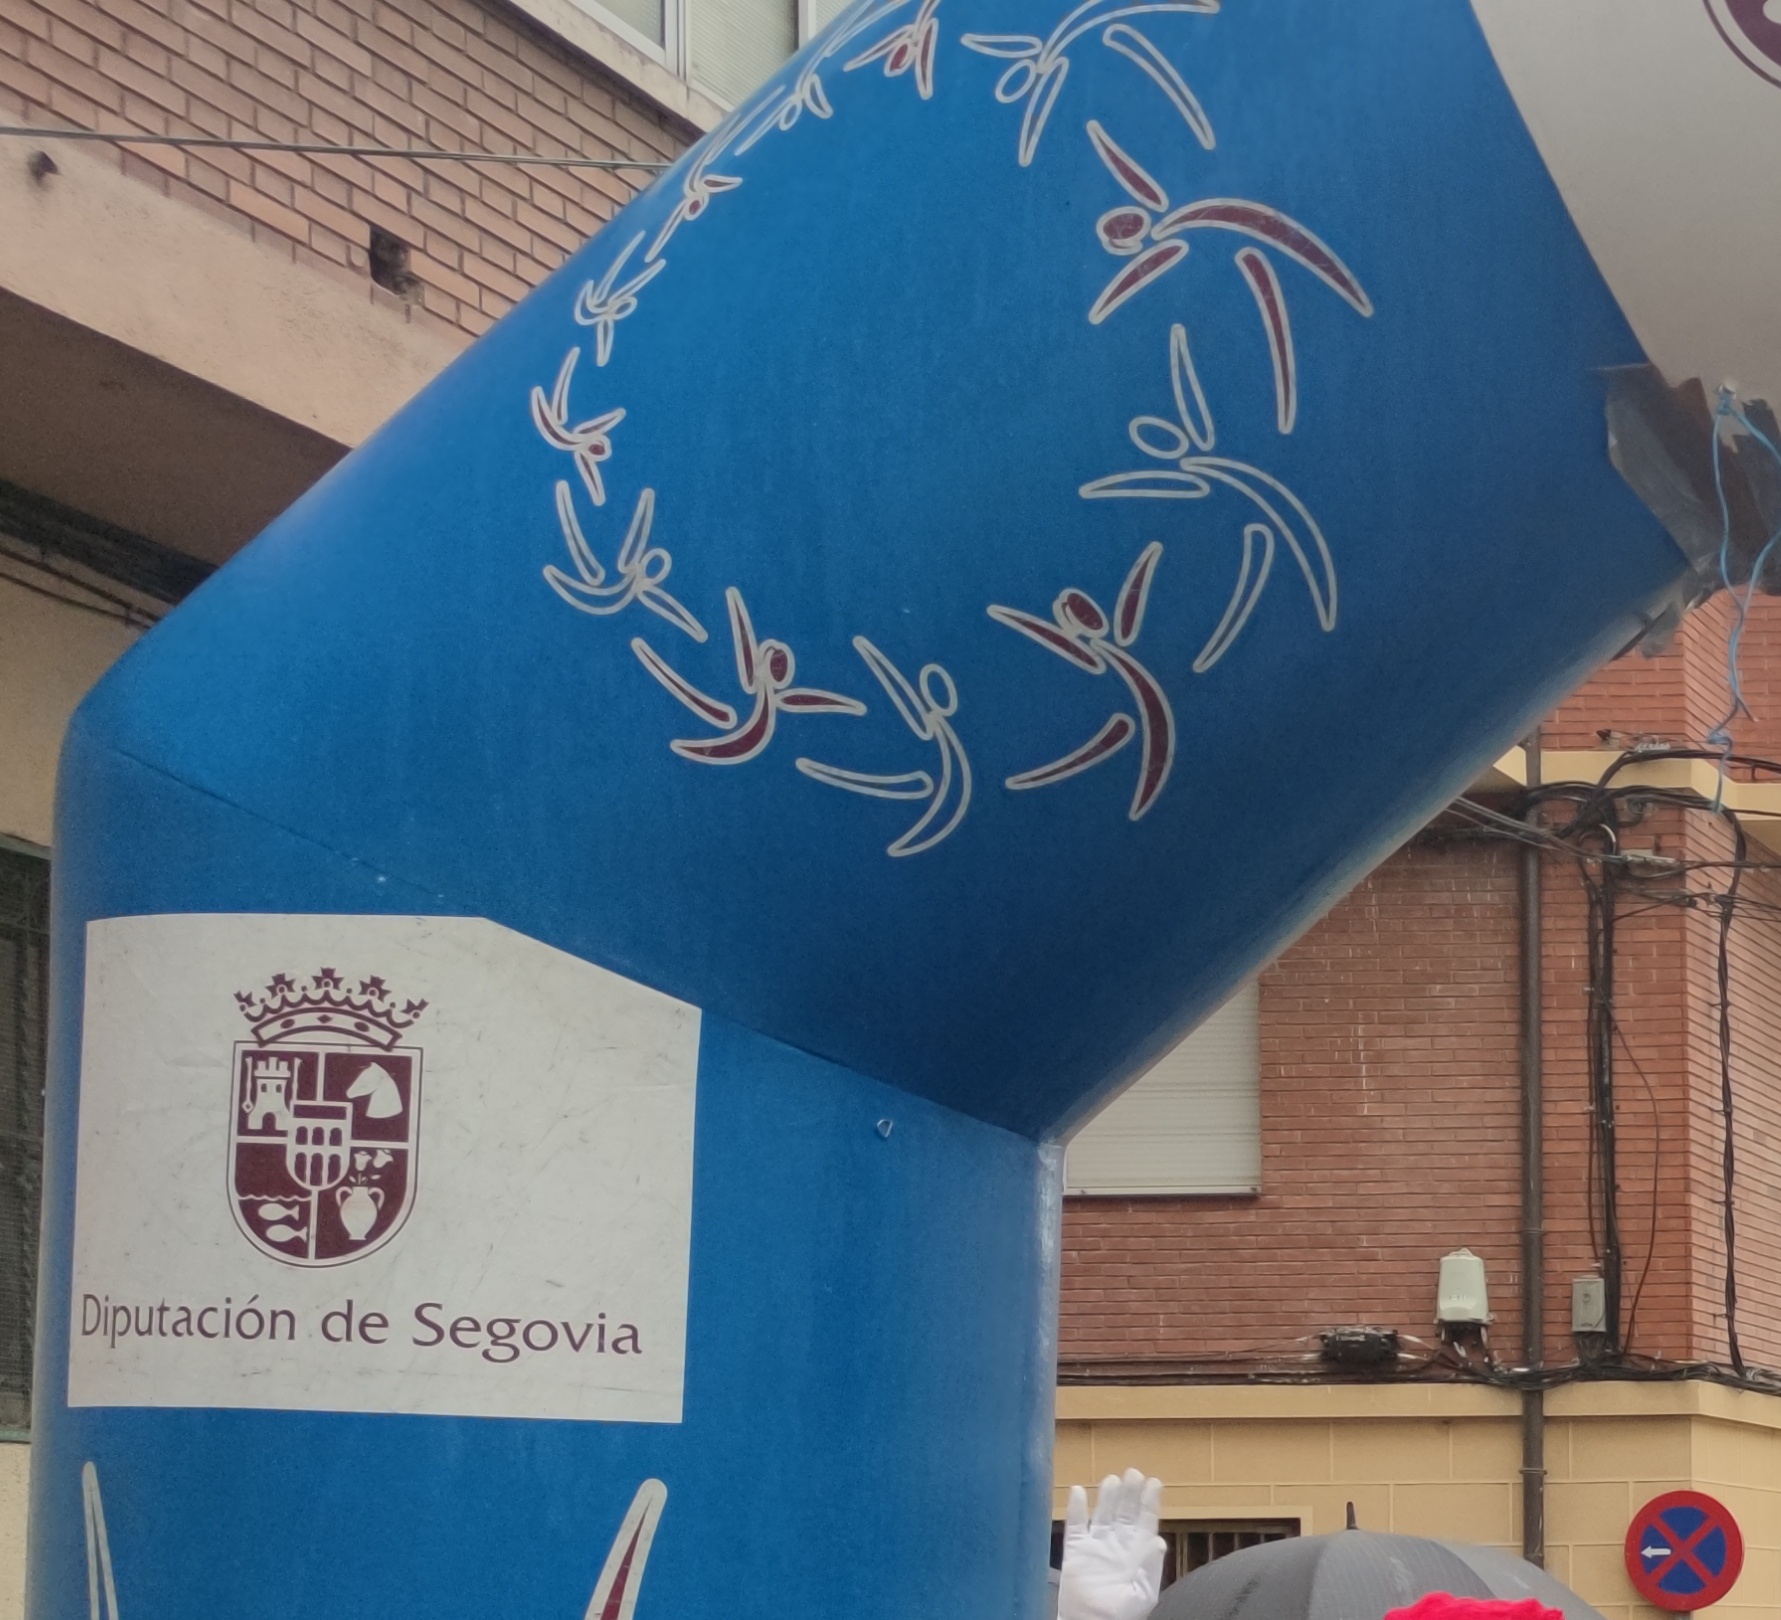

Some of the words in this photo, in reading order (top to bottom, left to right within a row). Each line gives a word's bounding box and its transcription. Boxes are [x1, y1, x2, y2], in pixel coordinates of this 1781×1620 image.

[81, 1294, 297, 1349] Diputación
[321, 1299, 390, 1345] de
[412, 1304, 643, 1363] Segovia
